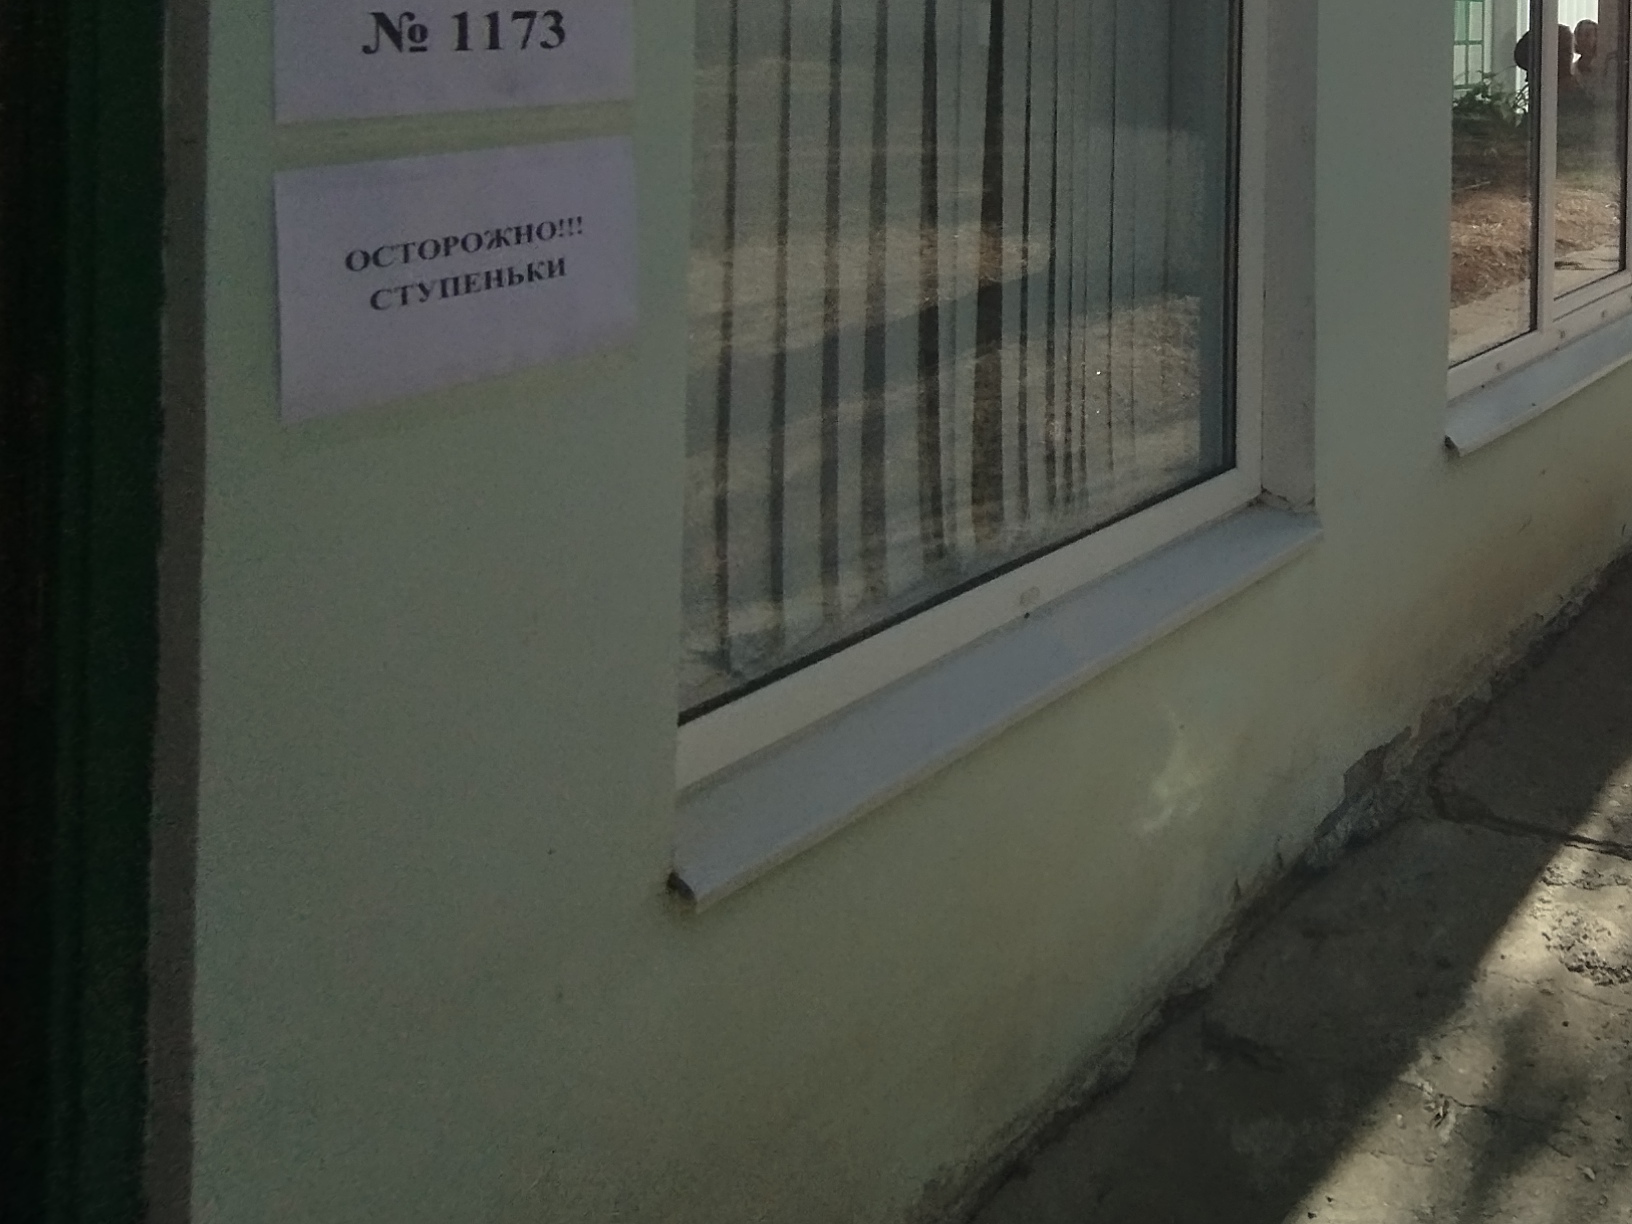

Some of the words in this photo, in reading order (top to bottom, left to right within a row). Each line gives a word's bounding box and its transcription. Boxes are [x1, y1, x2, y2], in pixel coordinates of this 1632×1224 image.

[361, 11, 430, 55] №
[450, 9, 567, 52] 1173
[344, 215, 584, 273] ОСТОРОЖНО!!!
[369, 257, 568, 312] СТУПЕНЬКИ
